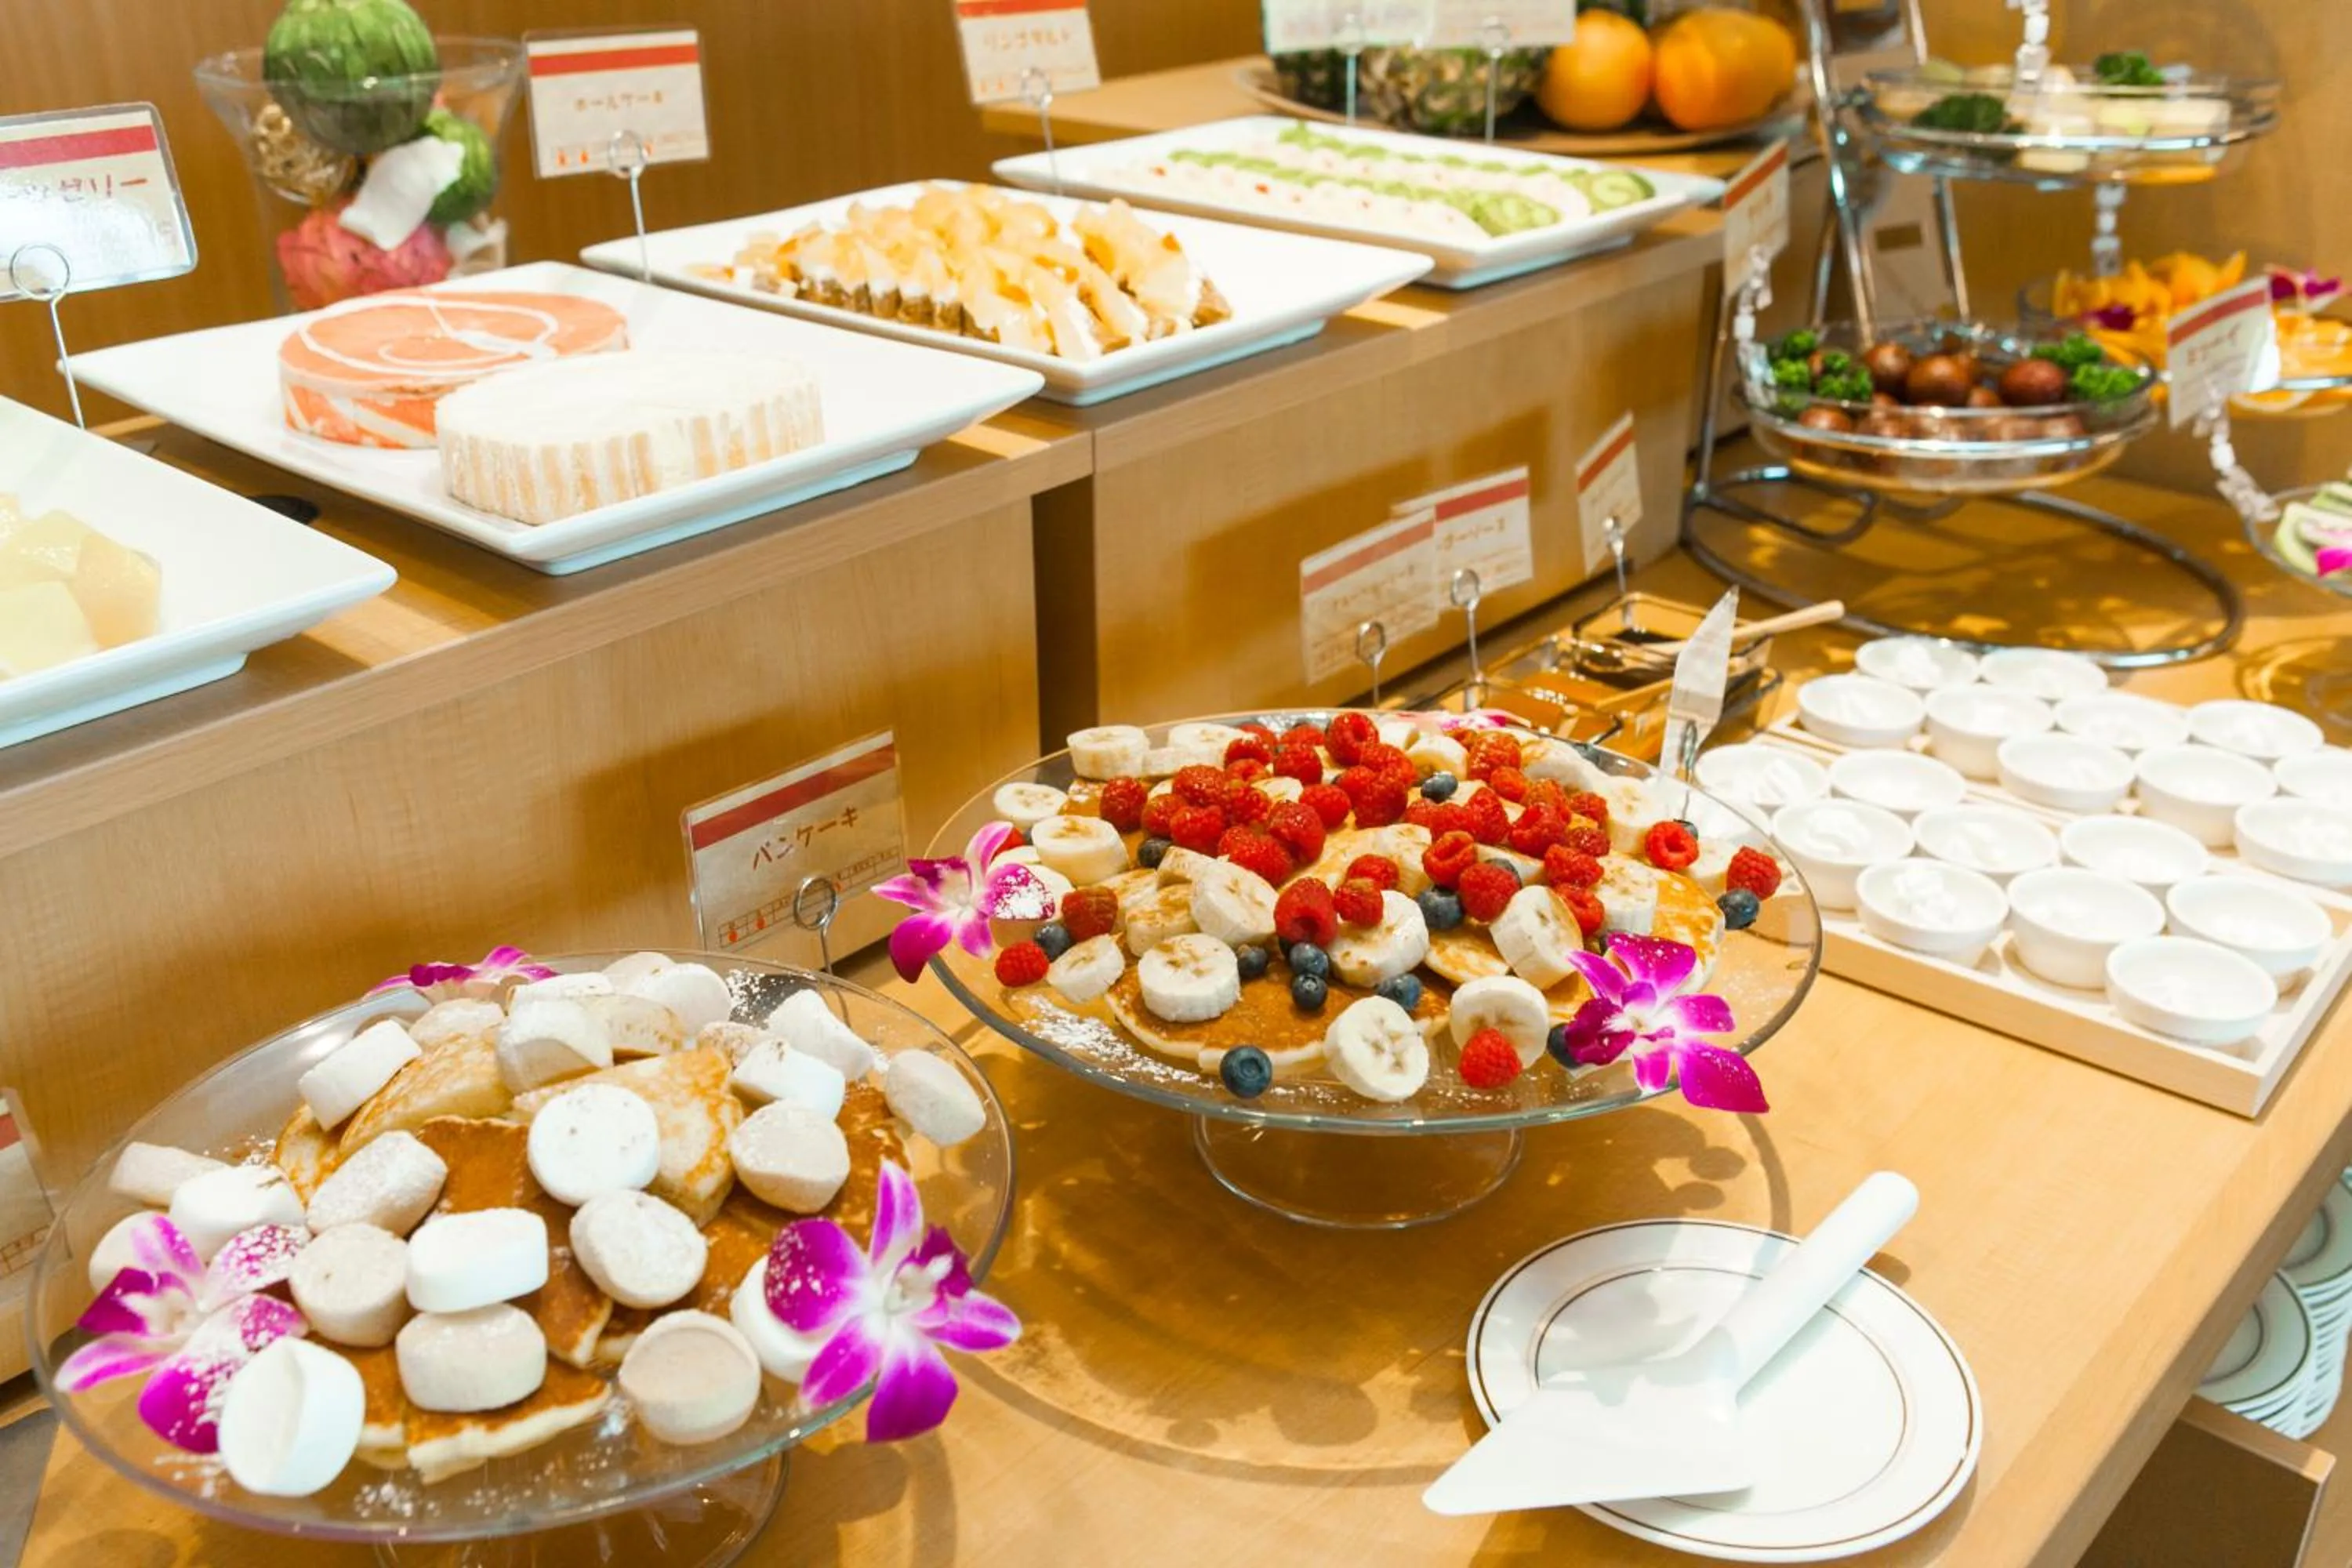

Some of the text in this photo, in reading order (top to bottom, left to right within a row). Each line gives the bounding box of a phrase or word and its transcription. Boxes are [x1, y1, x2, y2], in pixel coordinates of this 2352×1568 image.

[753, 806, 858, 871] パンケーキ
